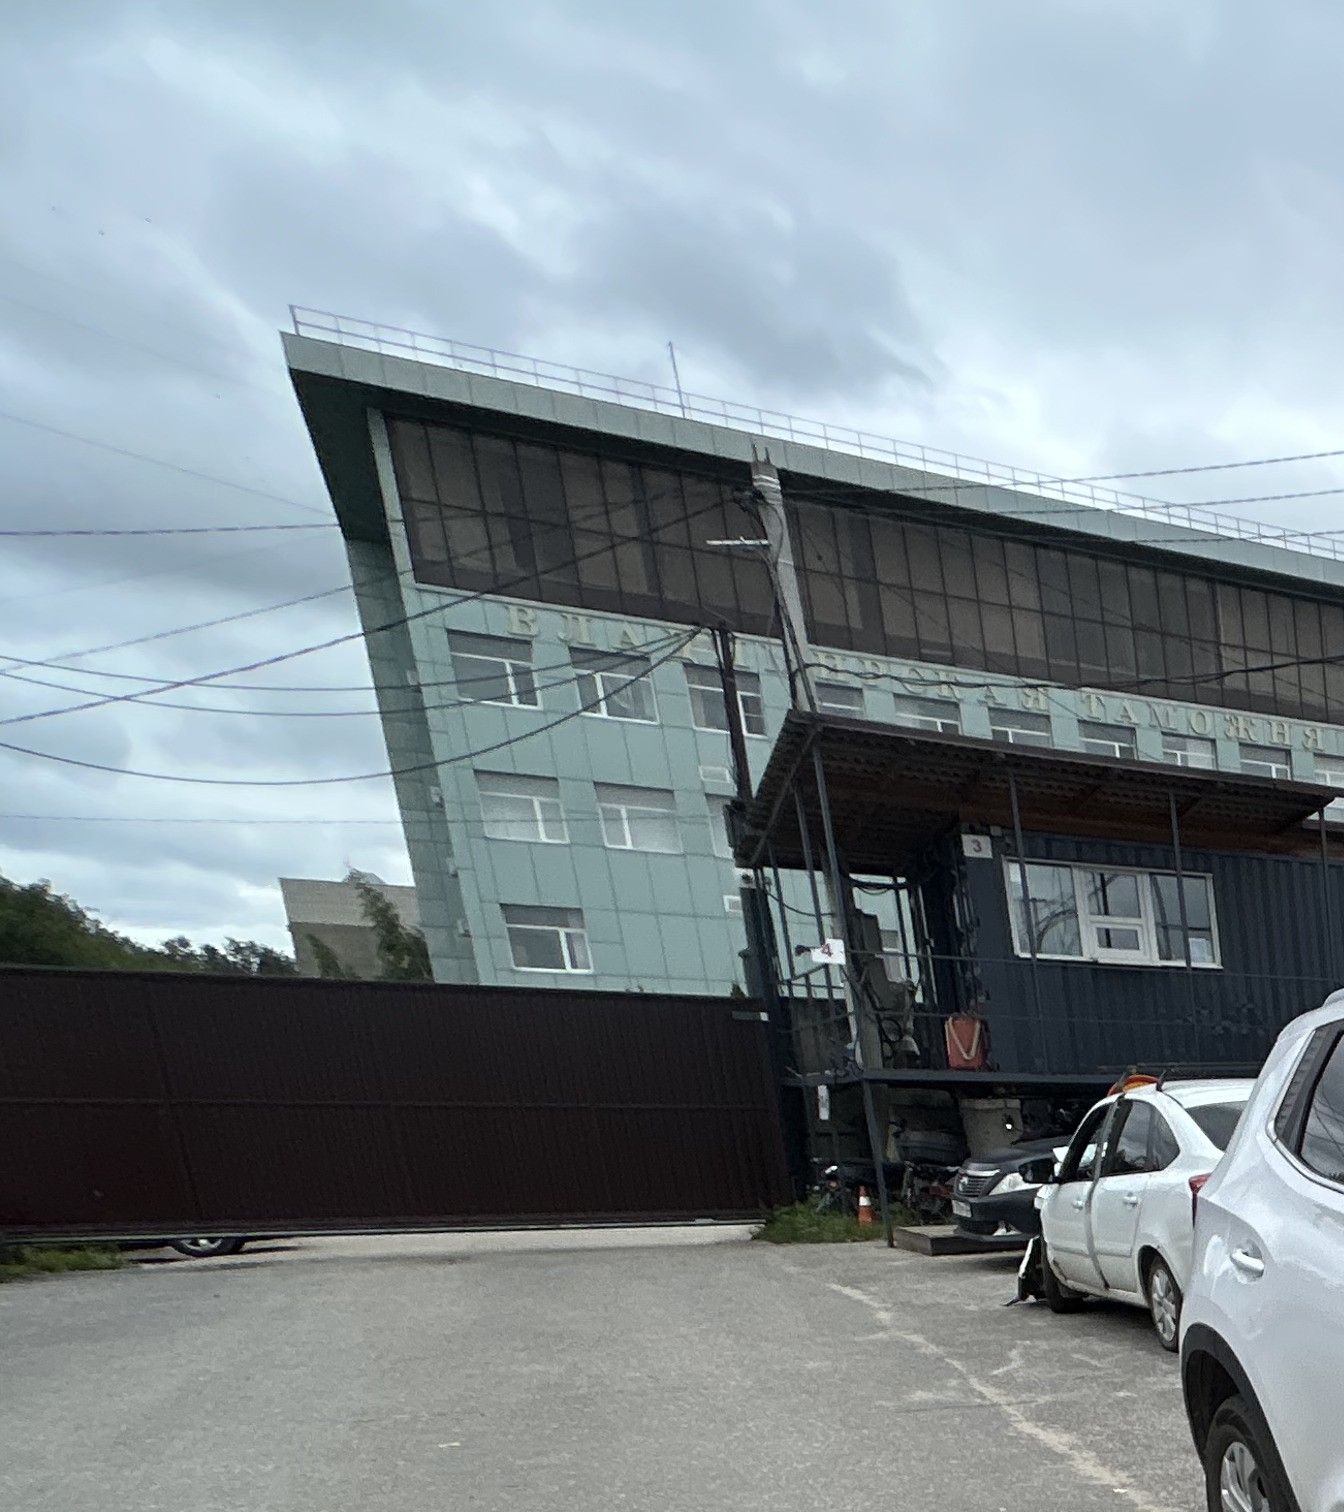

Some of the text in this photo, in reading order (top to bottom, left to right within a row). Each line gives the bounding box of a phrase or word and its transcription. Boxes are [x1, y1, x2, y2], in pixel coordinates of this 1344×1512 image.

[505, 604, 1325, 750] ВЛАИРСКАЯ ТАМОЖНЯ
[969, 839, 982, 853] 3
[821, 943, 834, 958] 4
